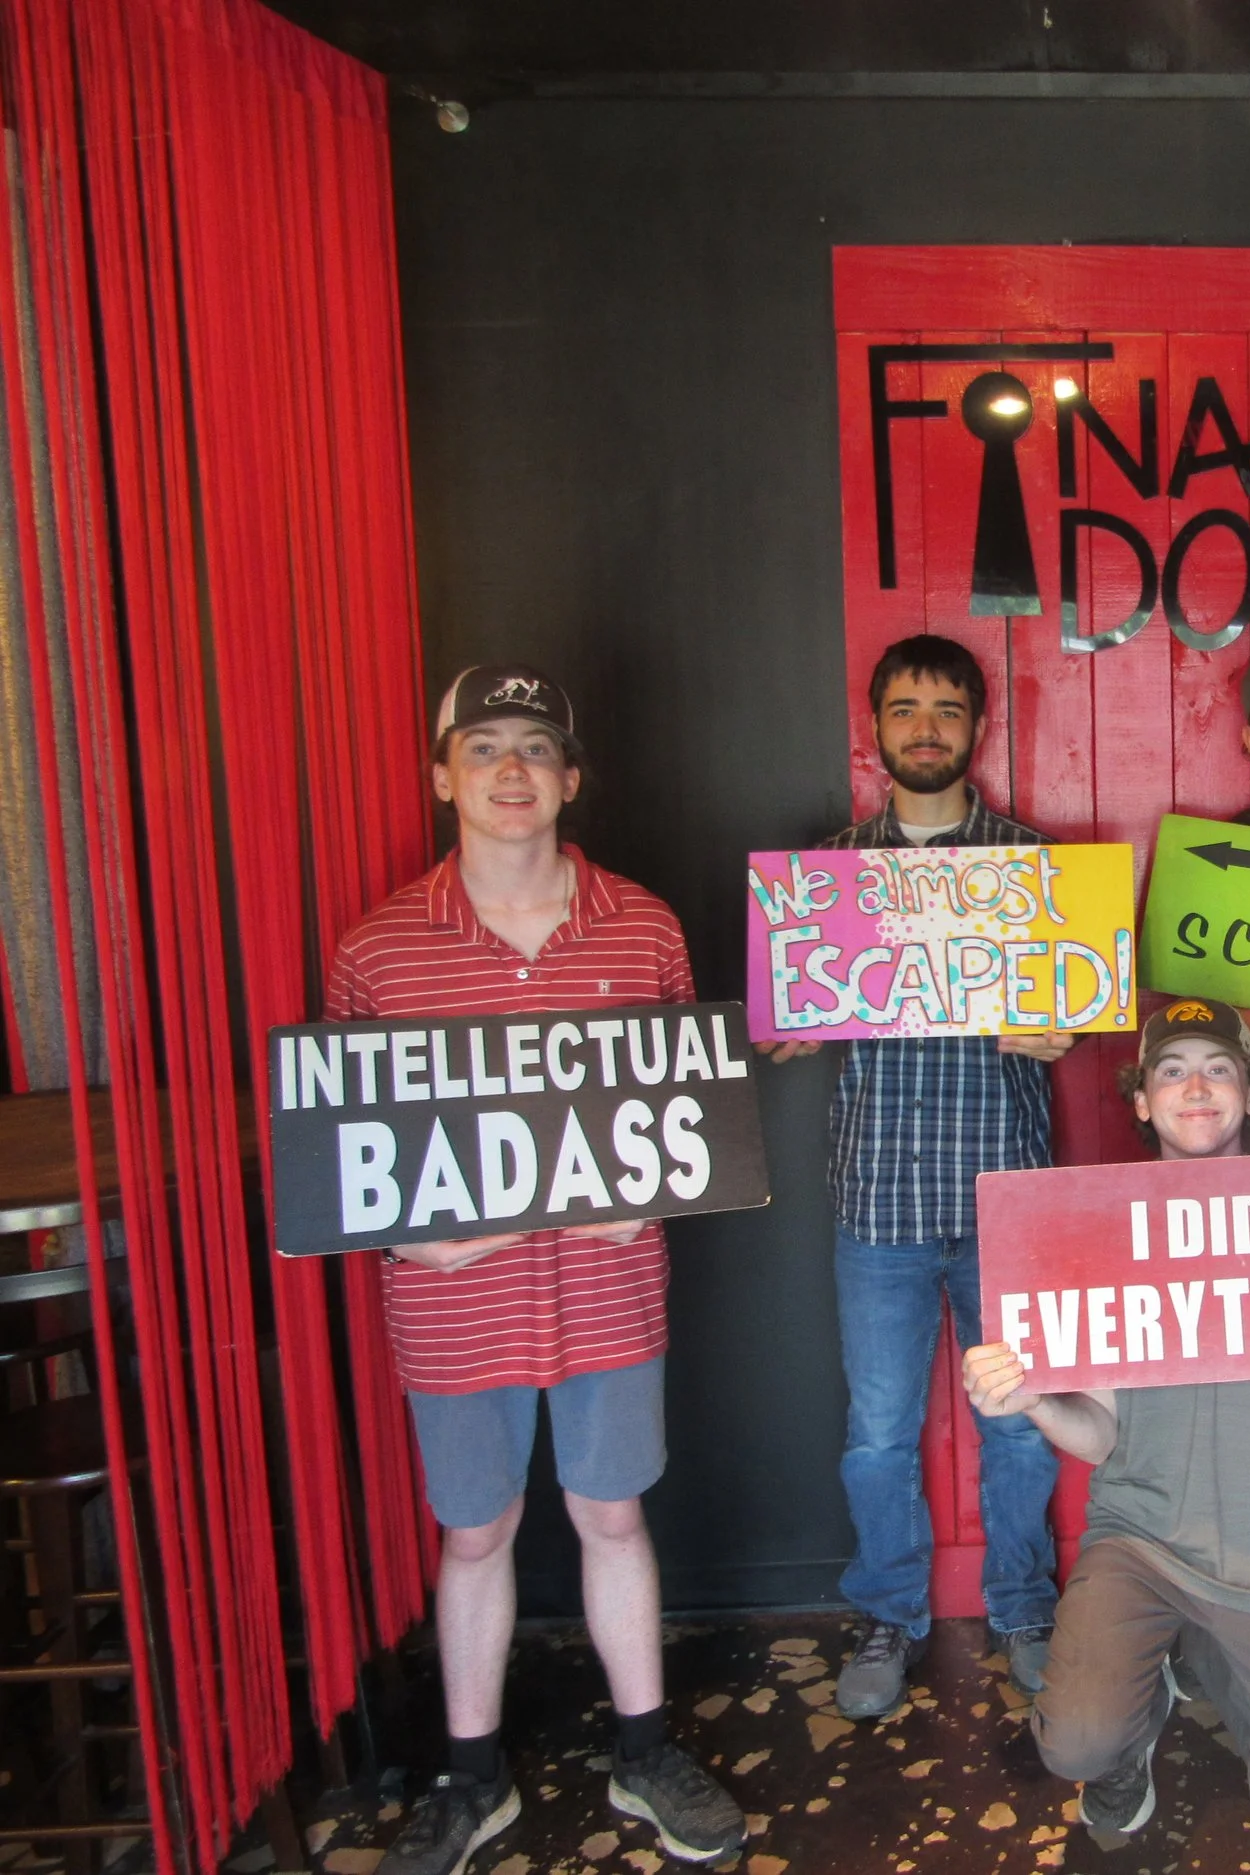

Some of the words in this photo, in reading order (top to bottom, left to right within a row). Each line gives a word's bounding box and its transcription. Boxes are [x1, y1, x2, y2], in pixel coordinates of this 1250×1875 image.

[749, 852, 840, 926] We
[856, 848, 1066, 926] almost
[768, 923, 1132, 1032] ESCAPED!
[278, 1013, 749, 1111] INTELLECTUAL
[338, 1094, 712, 1235] BADASS
[1130, 1200, 1150, 1261] I
